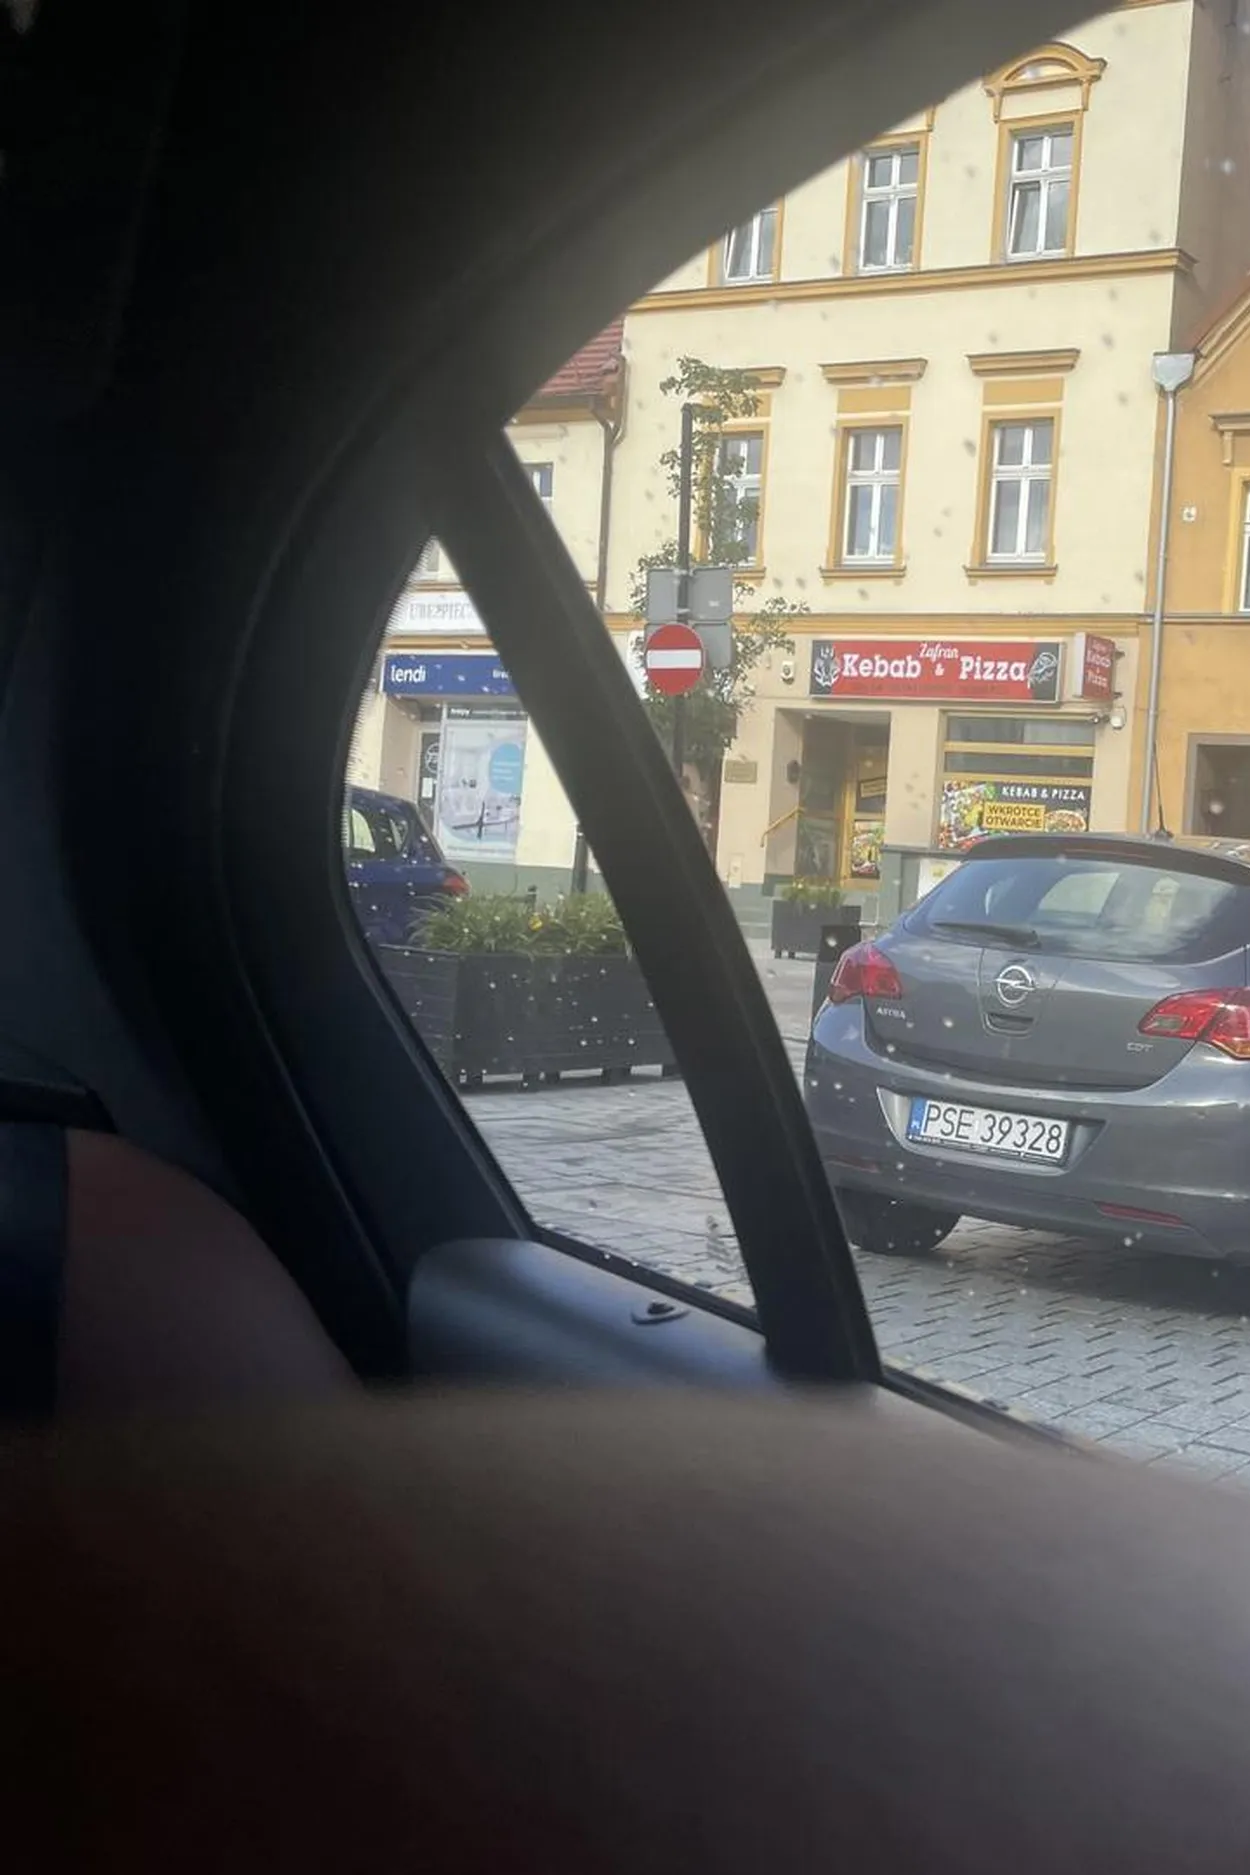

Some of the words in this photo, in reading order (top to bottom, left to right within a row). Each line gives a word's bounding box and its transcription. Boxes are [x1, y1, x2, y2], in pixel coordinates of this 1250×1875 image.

[919, 642, 960, 660] Zafran
[390, 664, 427, 682] lendi
[842, 653, 921, 679] Kebab
[933, 662, 945, 676] &
[959, 655, 1027, 681] Pizza
[1001, 786, 1038, 798] KEBAB
[1040, 788, 1049, 799] &
[1051, 788, 1086, 800] PIZZA
[985, 816, 1042, 829] OTWARCIE
[922, 1103, 975, 1140] PSE
[980, 1113, 1063, 1154] 39328
